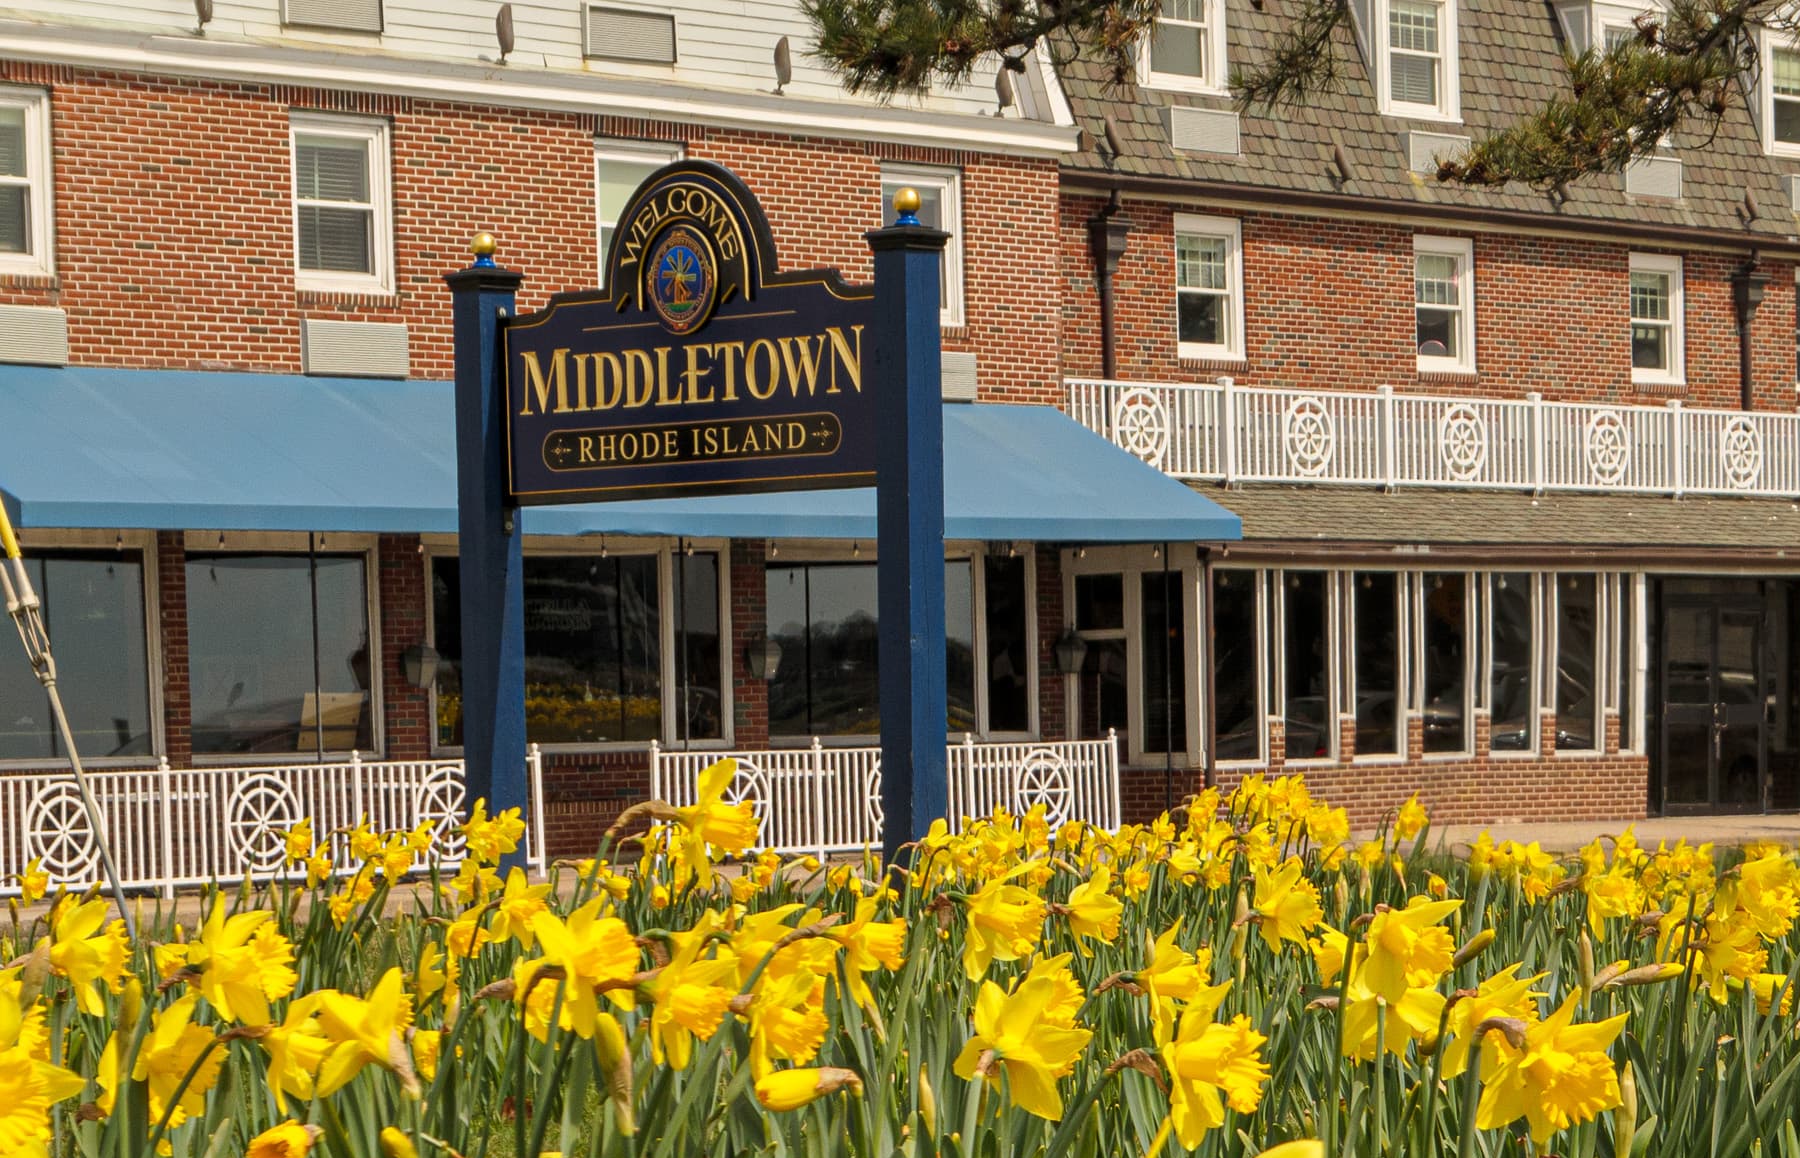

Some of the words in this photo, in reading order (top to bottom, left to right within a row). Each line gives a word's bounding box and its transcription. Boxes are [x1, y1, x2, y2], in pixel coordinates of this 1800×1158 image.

[620, 187, 740, 268] WELCOME
[519, 324, 865, 416] MIDDLETOWN
[578, 430, 680, 463] RHODE
[691, 422, 807, 456] ISLAND
